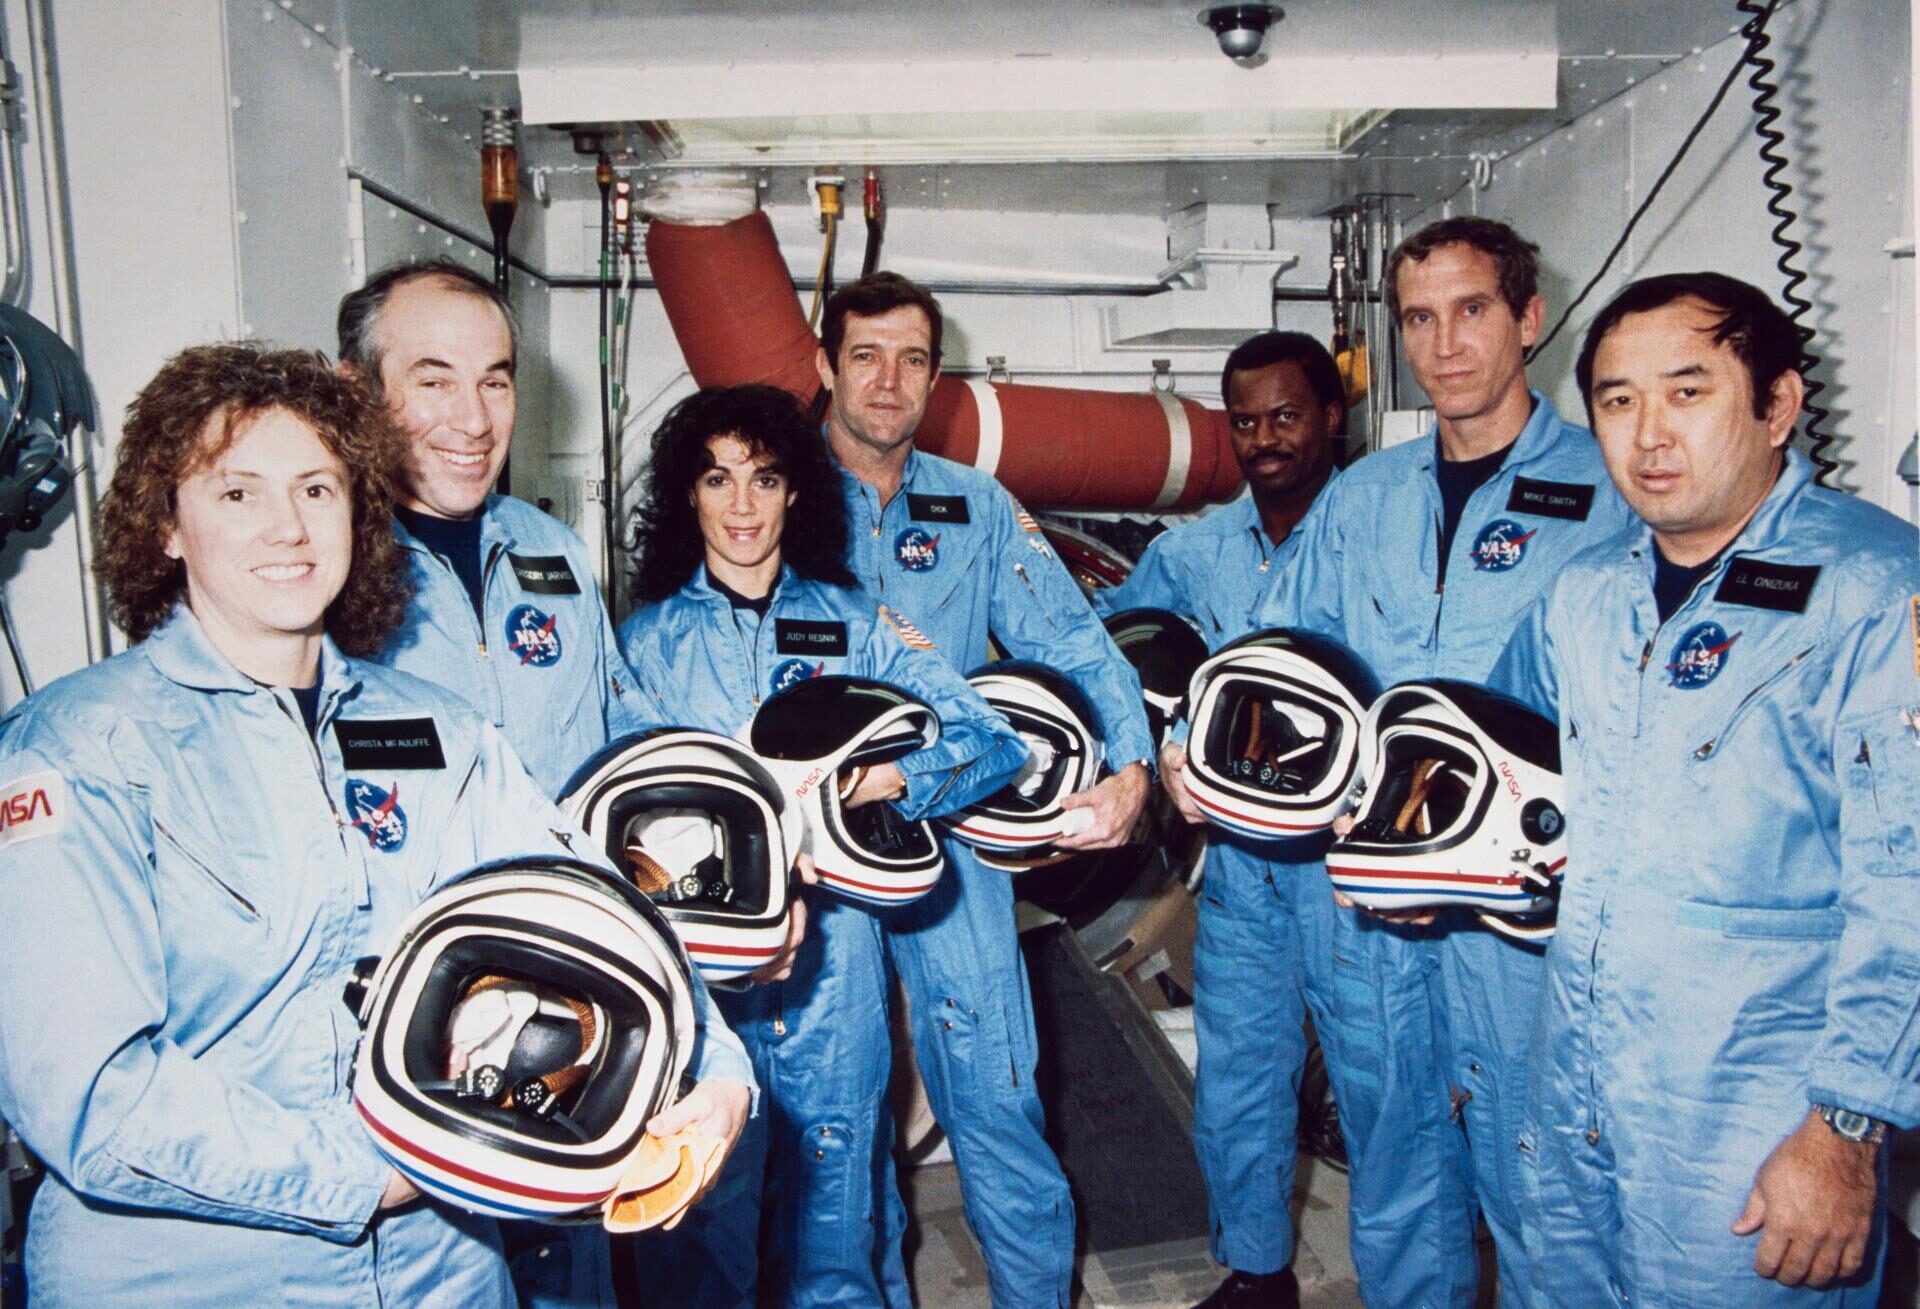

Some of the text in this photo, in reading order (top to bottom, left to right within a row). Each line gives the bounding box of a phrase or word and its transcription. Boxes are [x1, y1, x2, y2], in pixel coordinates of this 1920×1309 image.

[1522, 491, 1577, 507] MIKE SMITH
[900, 545, 934, 561] NASA
[1480, 541, 1521, 559] NASA
[514, 629, 558, 653] NASA
[786, 632, 838, 643] JUDY RESNIK
[1679, 649, 1720, 671] NASA
[348, 739, 382, 748] CHRISTA
[398, 737, 431, 748] AULIFFE
[796, 767, 824, 798] NASA
[1498, 761, 1522, 803] NASA
[0, 789, 53, 832] ASA
